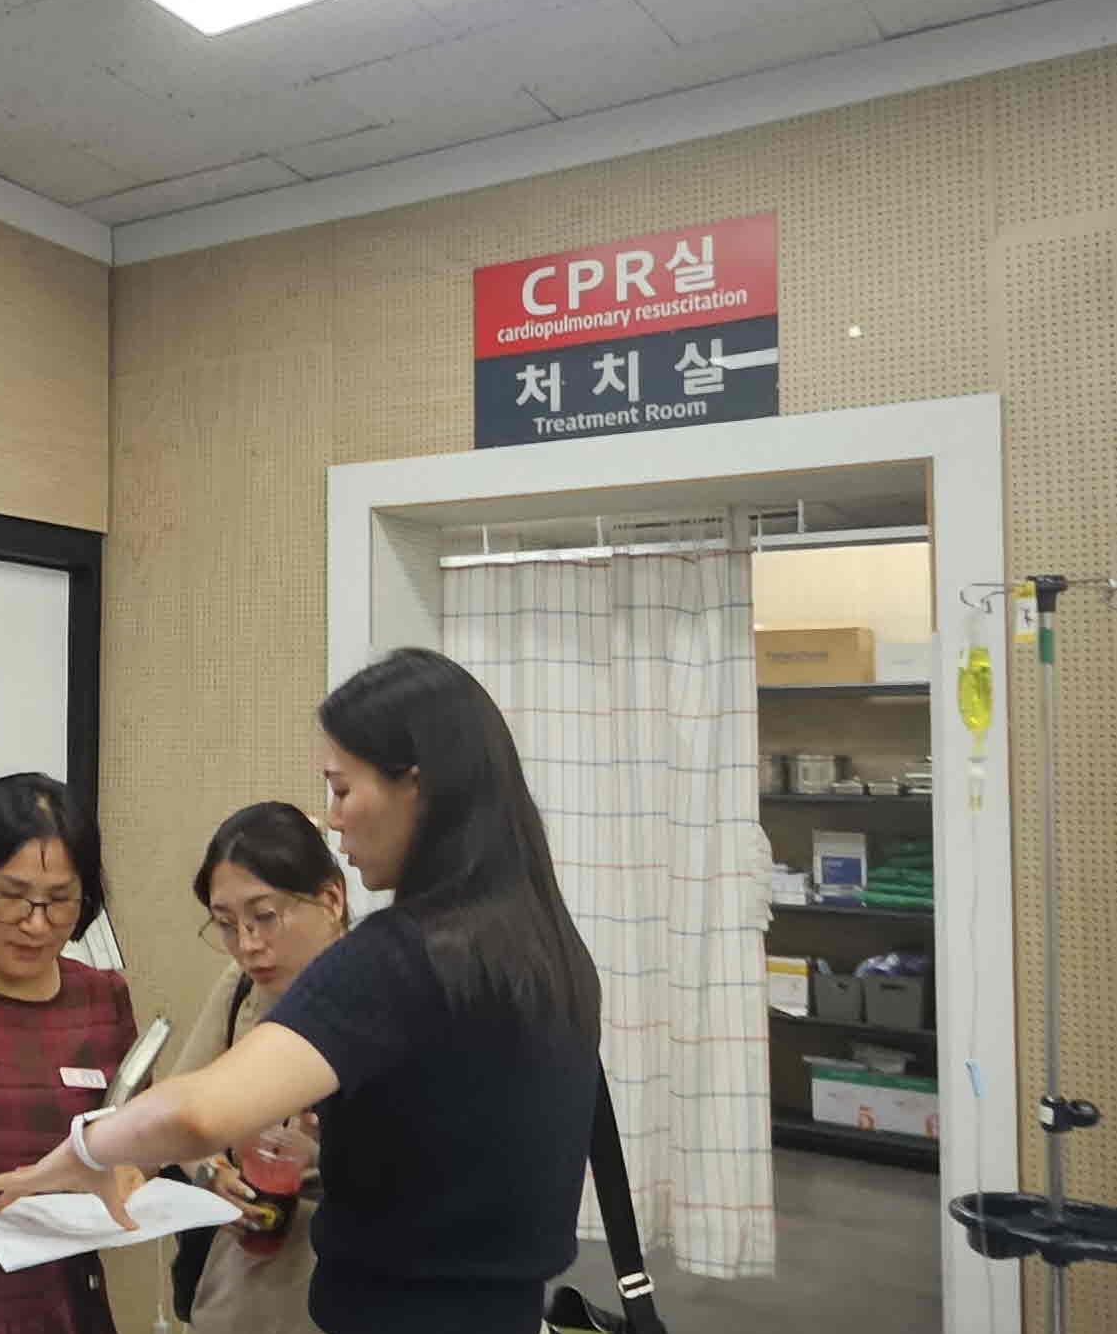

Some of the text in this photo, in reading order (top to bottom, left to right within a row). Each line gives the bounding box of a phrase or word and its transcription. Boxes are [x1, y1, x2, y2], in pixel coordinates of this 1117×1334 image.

[521, 234, 716, 317] CPR실
[496, 287, 748, 344] cardiopulmonary resuscitation
[533, 397, 708, 436] Treatment Room
